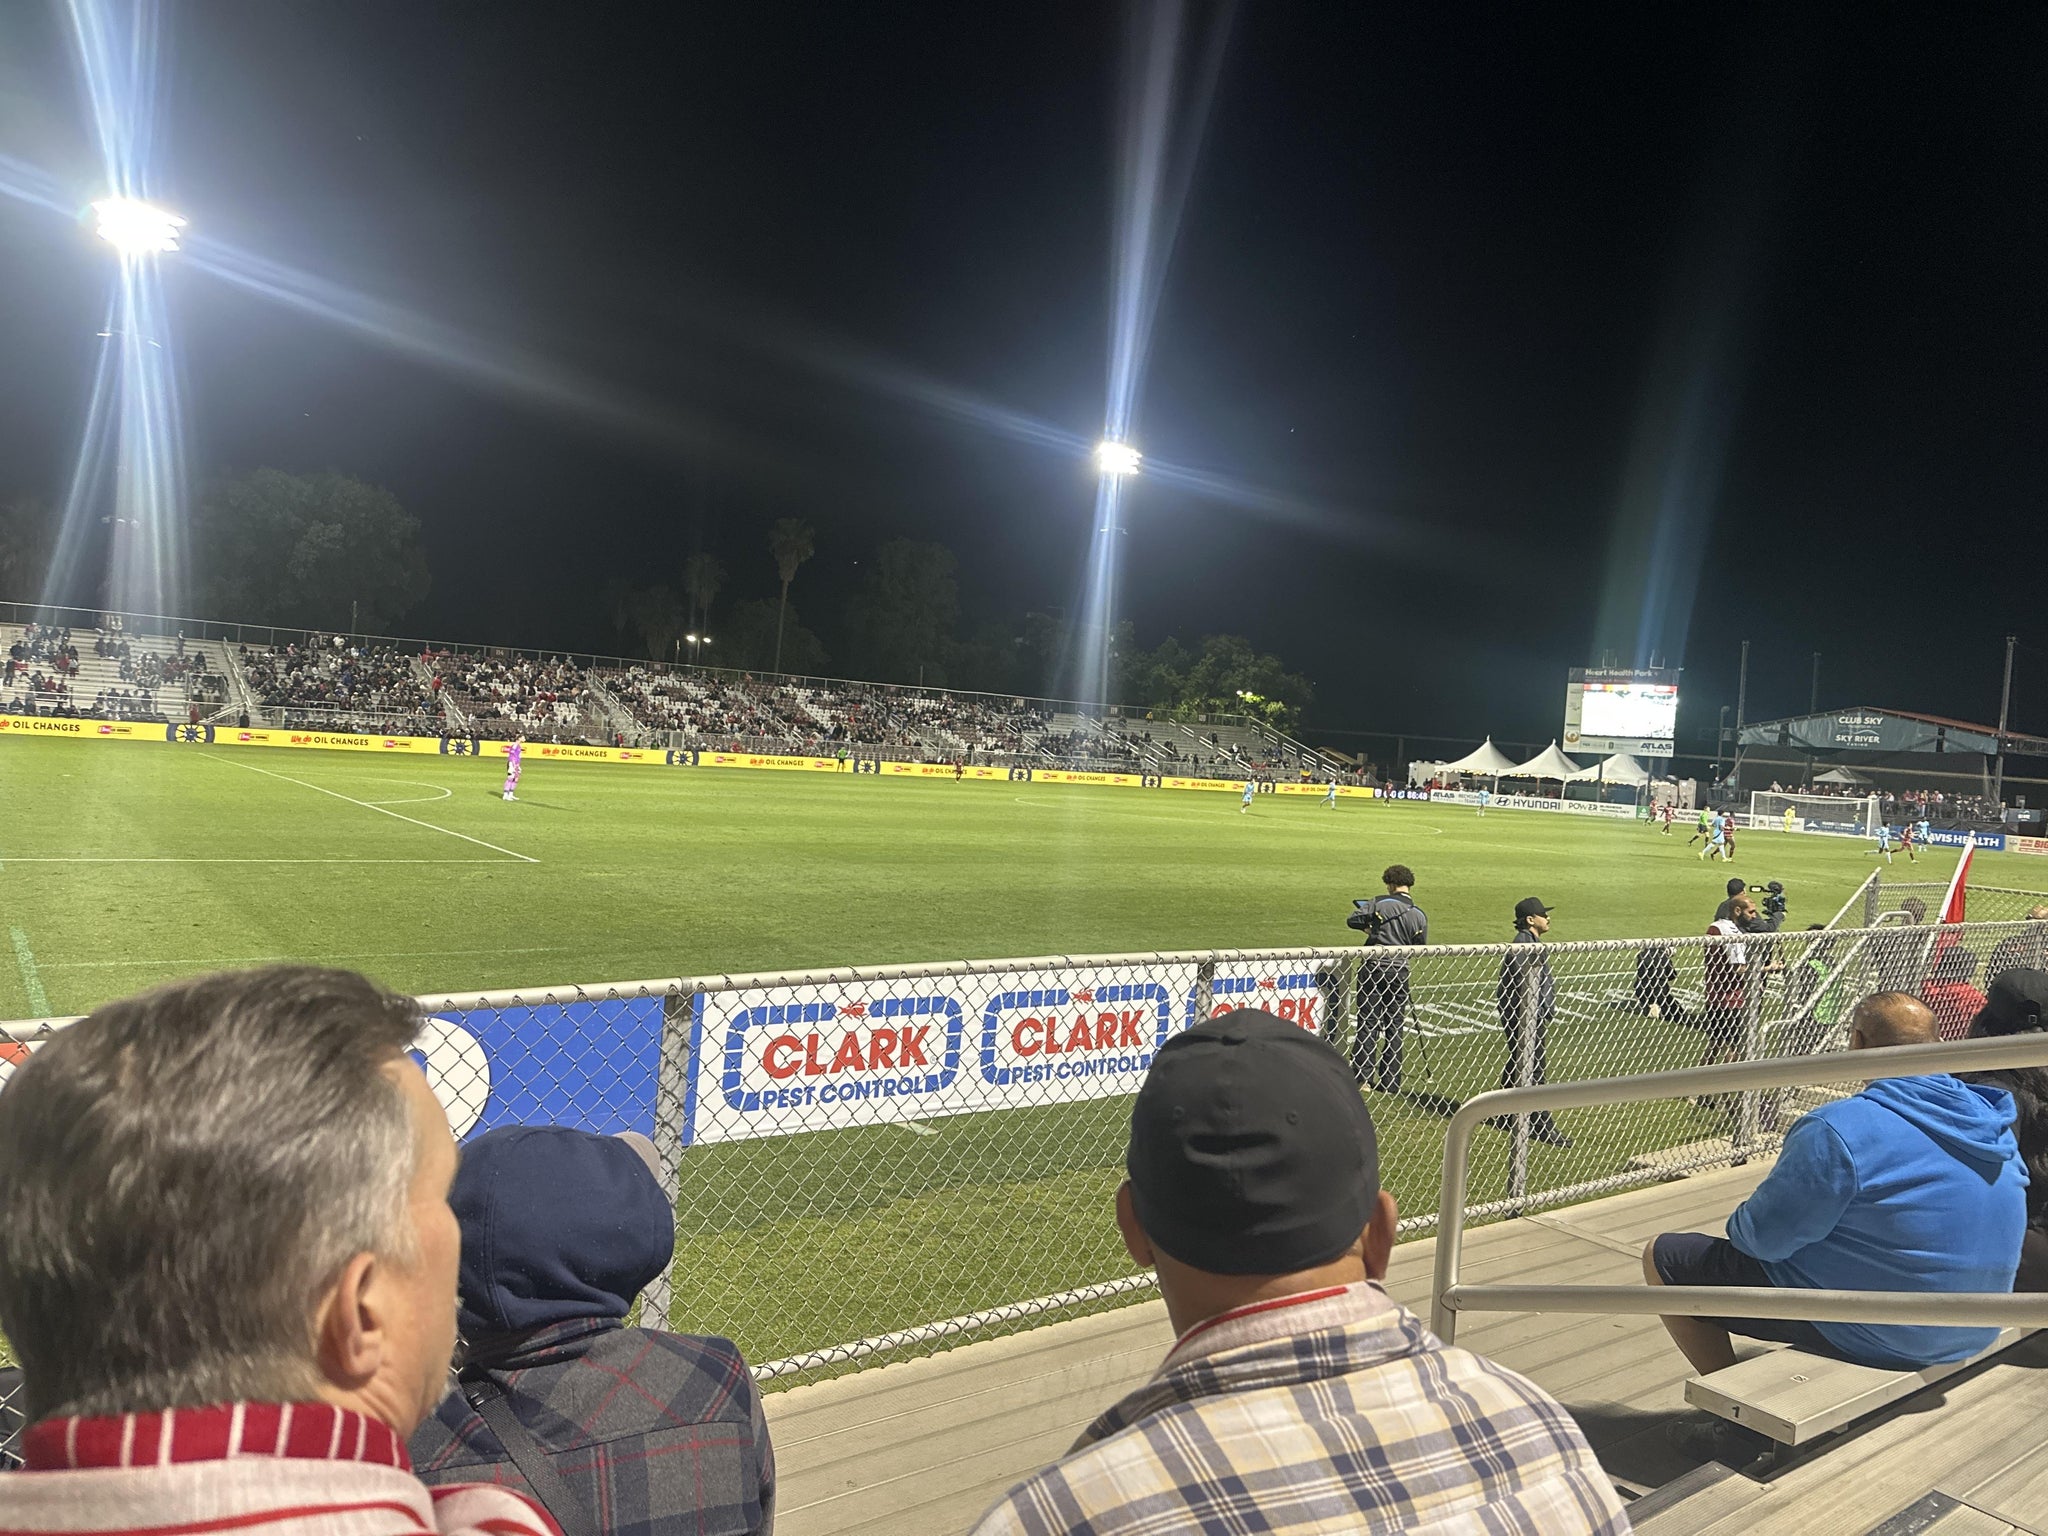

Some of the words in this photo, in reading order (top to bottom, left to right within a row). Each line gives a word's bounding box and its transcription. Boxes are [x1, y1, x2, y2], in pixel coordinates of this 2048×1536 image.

[1839, 716, 1861, 724] CLUB
[1863, 717, 1883, 725] SKY
[13, 721, 30, 729] OIL
[33, 722, 80, 732] CHANGES
[330, 737, 369, 746] CHANGES
[1835, 734, 1852, 742] SKY
[1854, 735, 1880, 743] RIVER
[1513, 799, 1560, 810] HYUNDAI
[1568, 802, 1598, 811] POWER
[1011, 1009, 1145, 1057] CLARK
[762, 1025, 931, 1080] CLARK
[1011, 1063, 1054, 1085] PEST
[1056, 1054, 1142, 1080] CONTROL
[762, 1085, 816, 1110] PEST
[819, 1075, 926, 1104] CONTROL
[1732, 1405, 1740, 1419] 1
